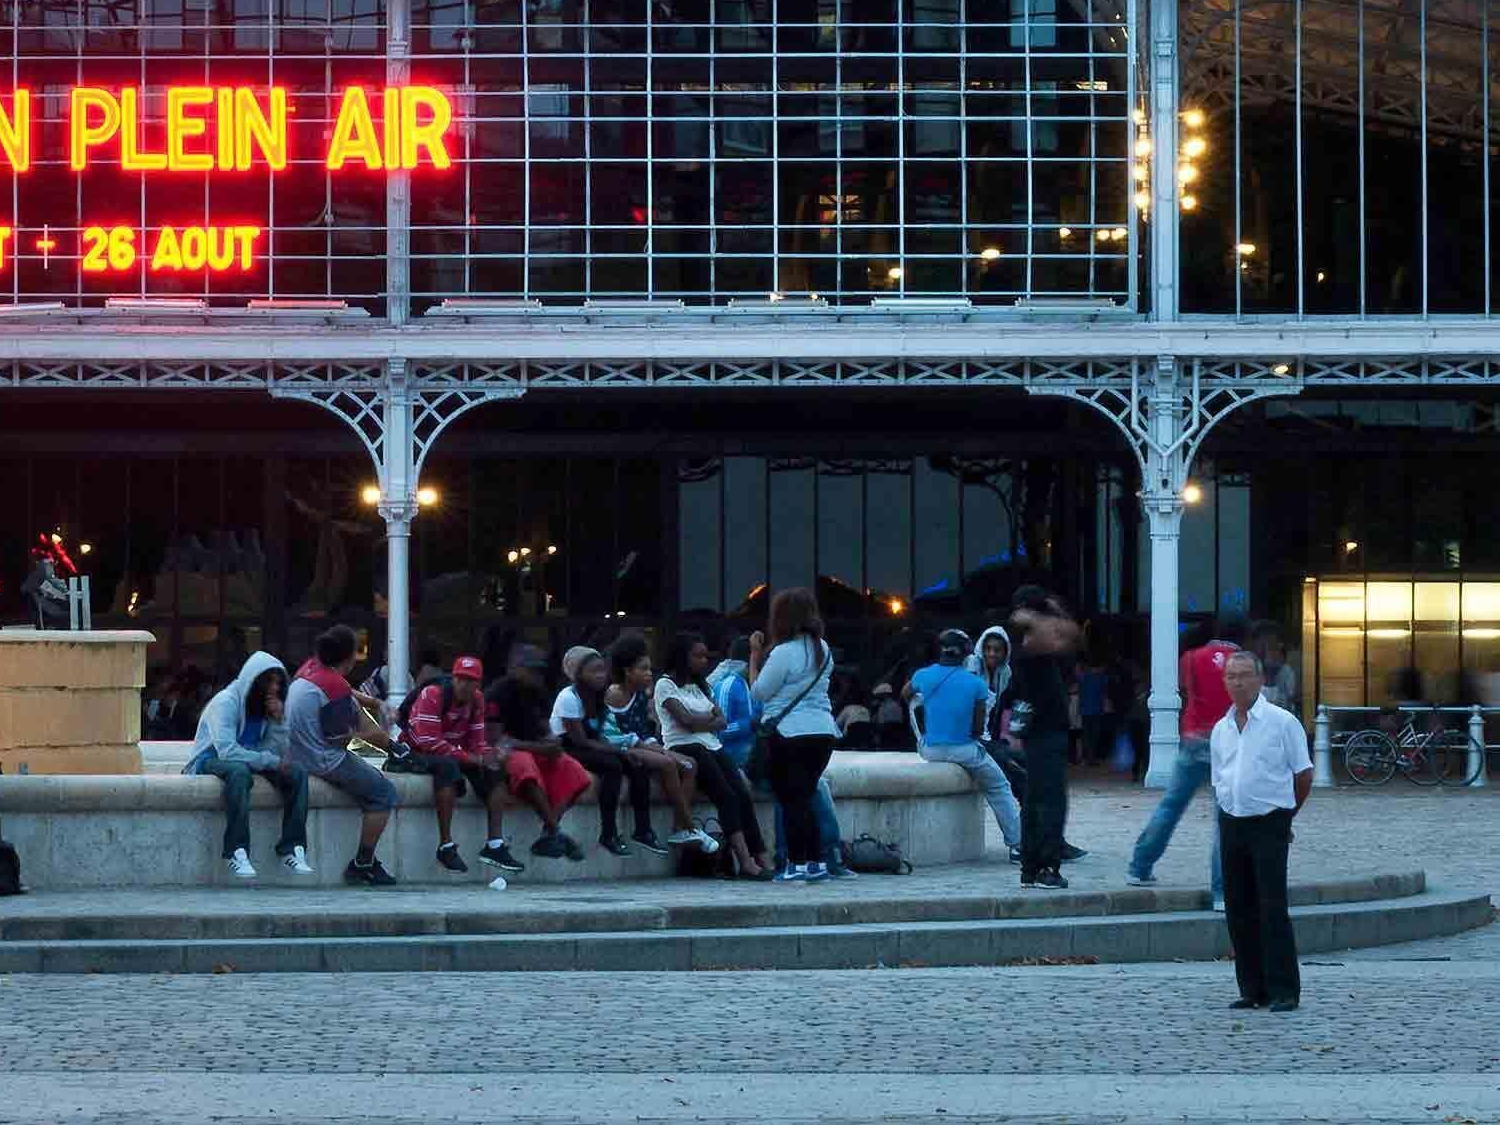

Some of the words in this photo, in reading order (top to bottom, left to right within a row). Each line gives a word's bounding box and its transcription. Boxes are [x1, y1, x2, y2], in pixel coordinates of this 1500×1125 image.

[69, 84, 288, 174] PLEIN
[323, 83, 456, 173] AIR
[80, 224, 137, 273] 26
[149, 224, 263, 272] AOUT
